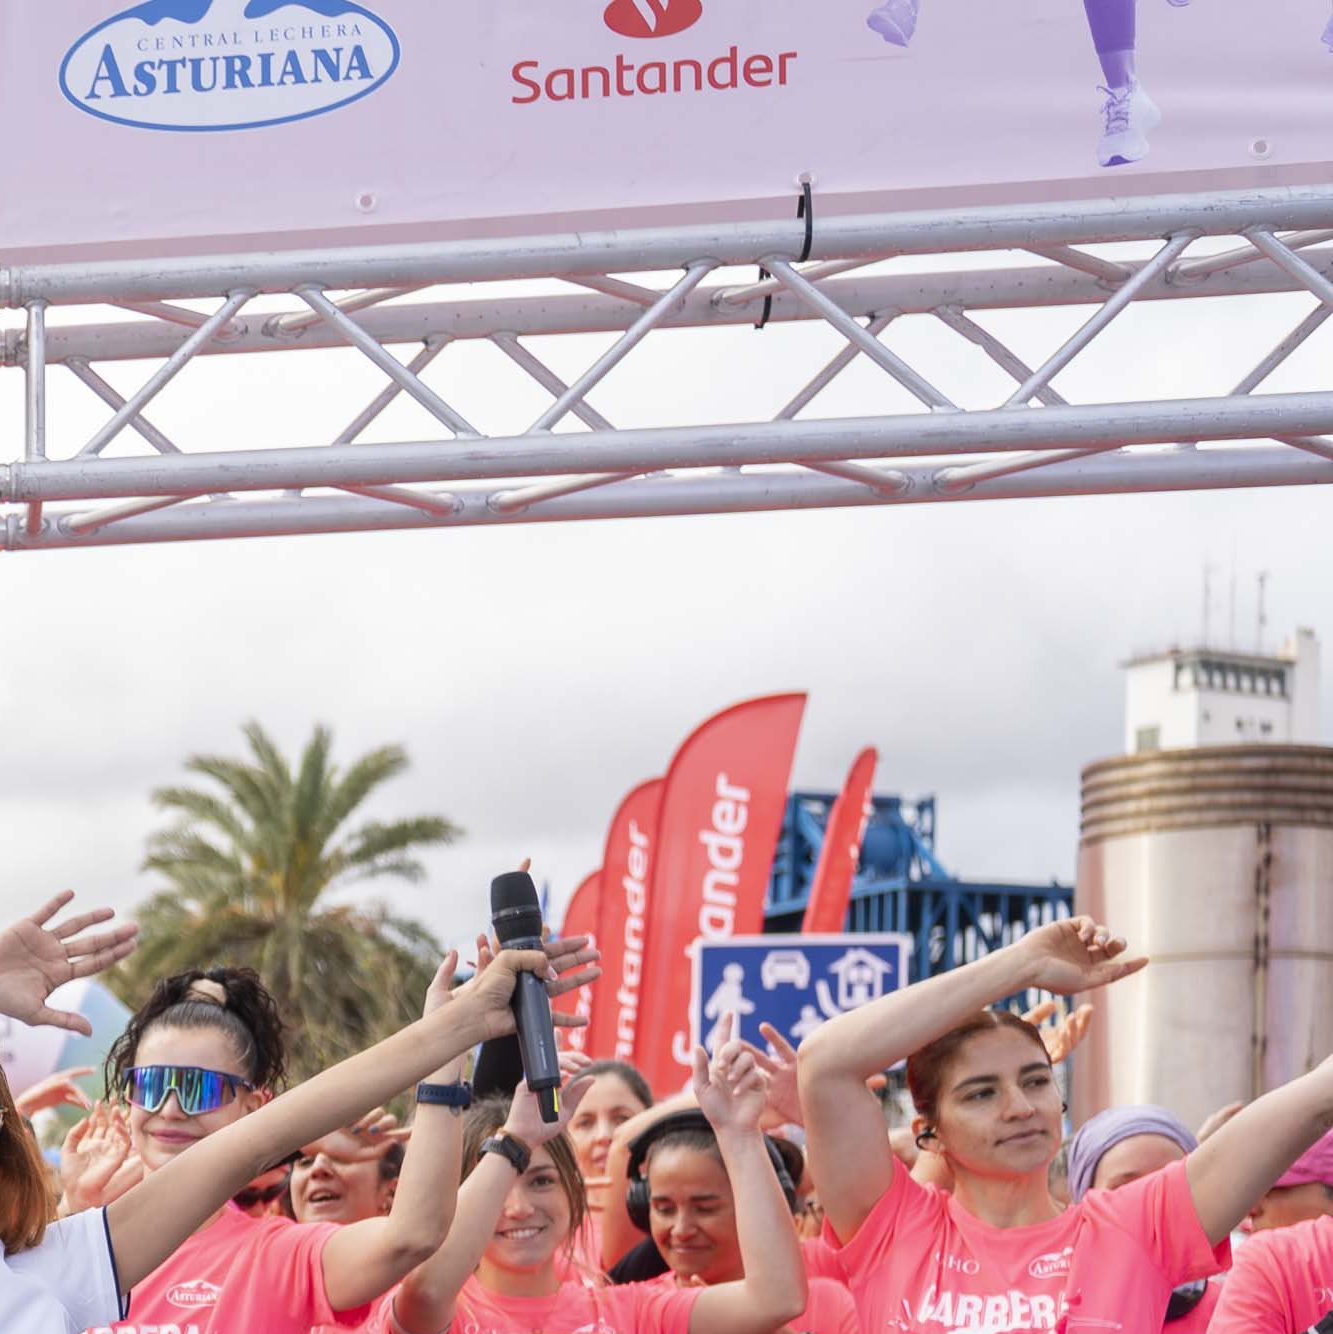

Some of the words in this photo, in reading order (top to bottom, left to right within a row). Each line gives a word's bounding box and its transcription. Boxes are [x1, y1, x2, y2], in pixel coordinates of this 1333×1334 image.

[136, 29, 243, 53] CENTRAL
[254, 23, 363, 45] LECHERA
[83, 42, 375, 101] ASTURIANA
[510, 46, 798, 105] Santander
